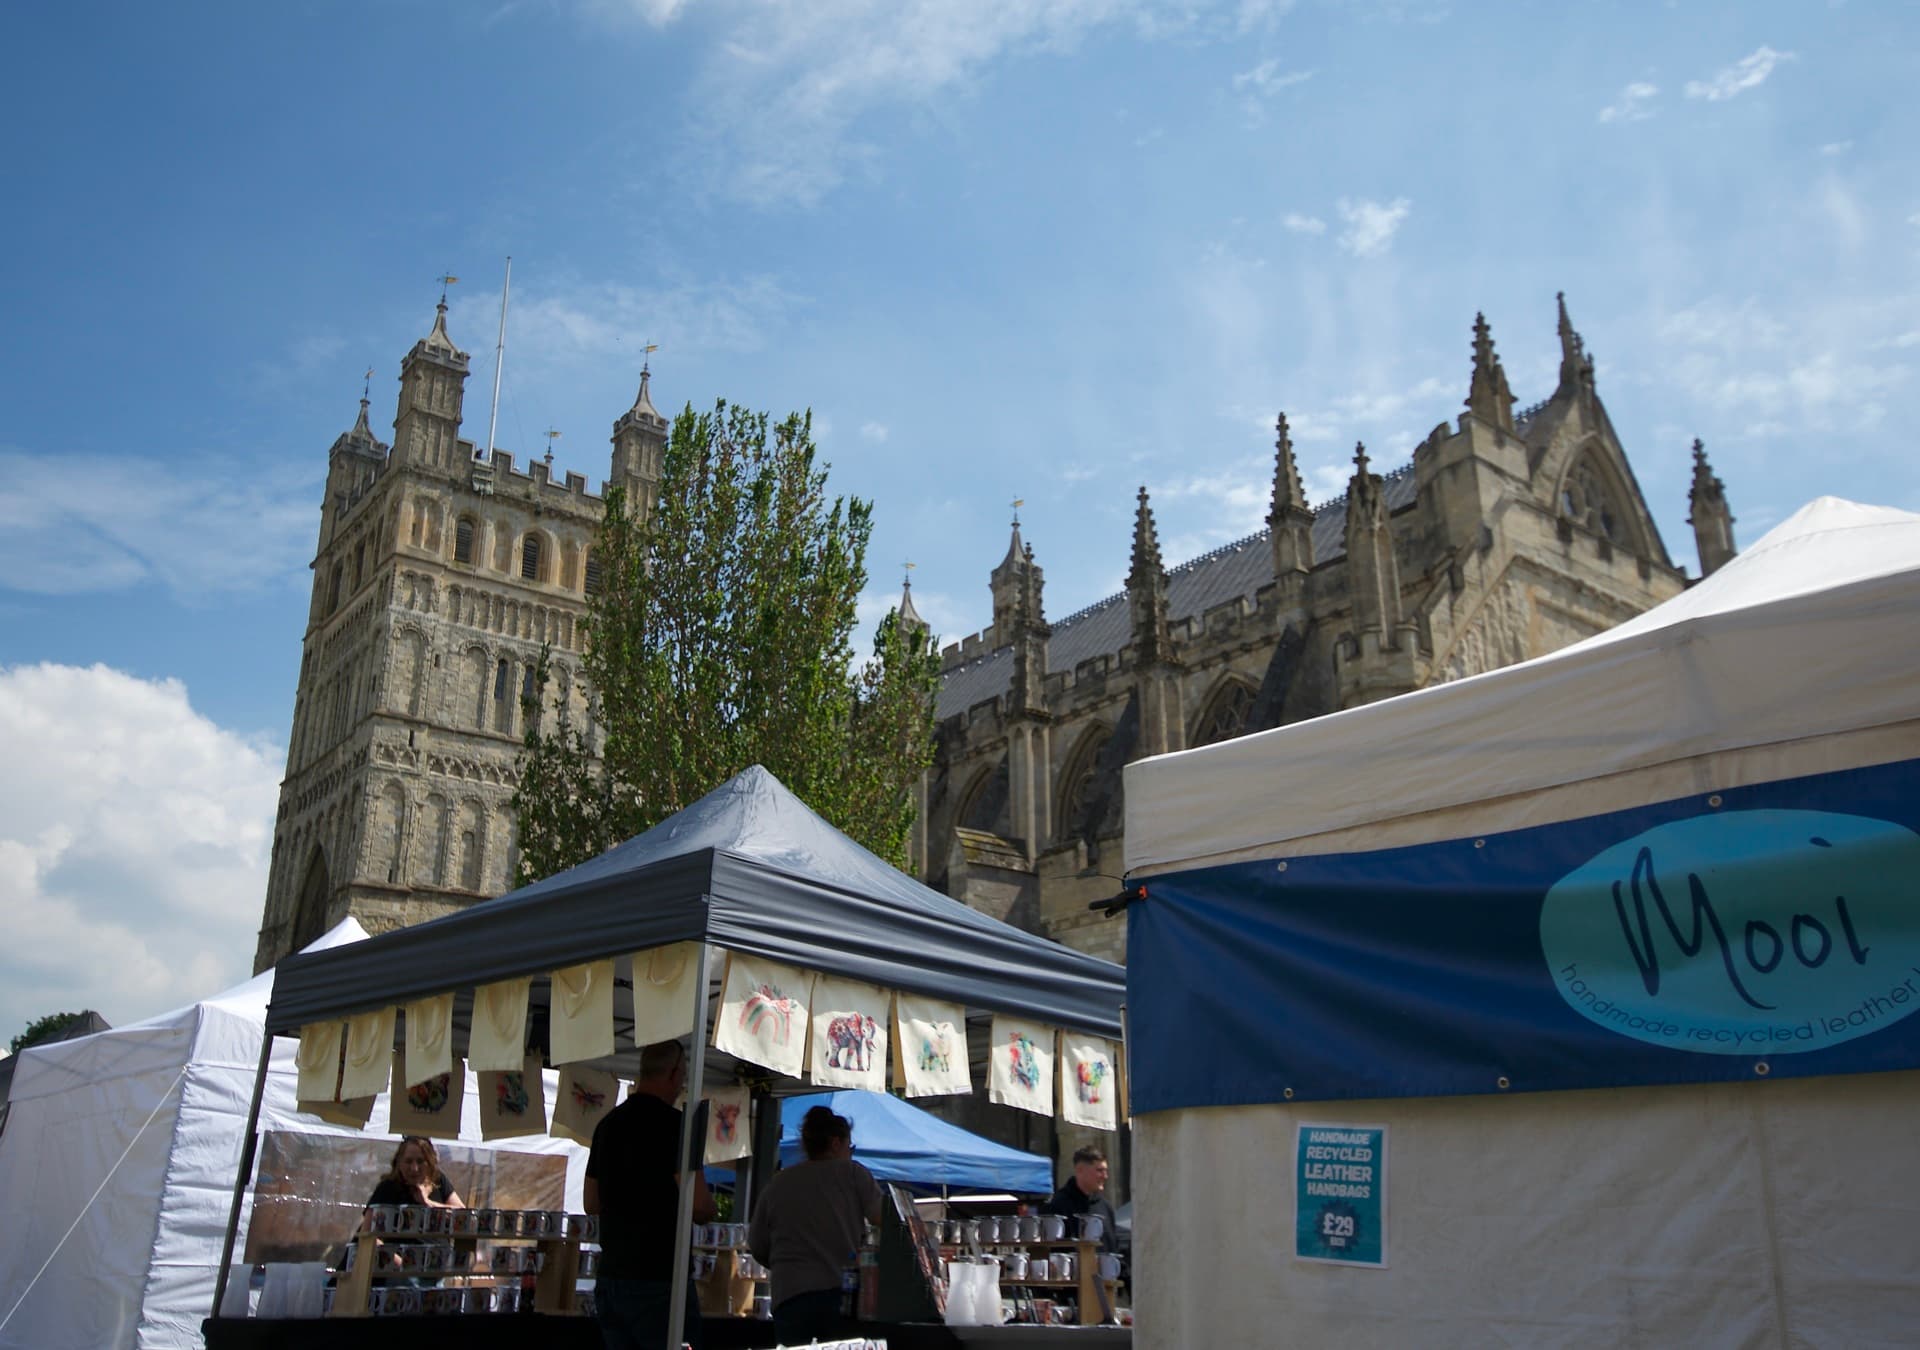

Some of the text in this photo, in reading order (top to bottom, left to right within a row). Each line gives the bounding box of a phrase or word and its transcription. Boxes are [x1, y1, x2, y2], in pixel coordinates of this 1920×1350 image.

[1612, 836, 1870, 1010] Mooi
[1561, 962, 1918, 1047] handmade recycled leather
[1310, 1131, 1371, 1145] HANDMADE
[1306, 1146, 1373, 1162] RECYCLED
[1304, 1163, 1373, 1182] LEATHER
[1307, 1182, 1371, 1199] HANDBAGS
[1323, 1212, 1354, 1237] £29
